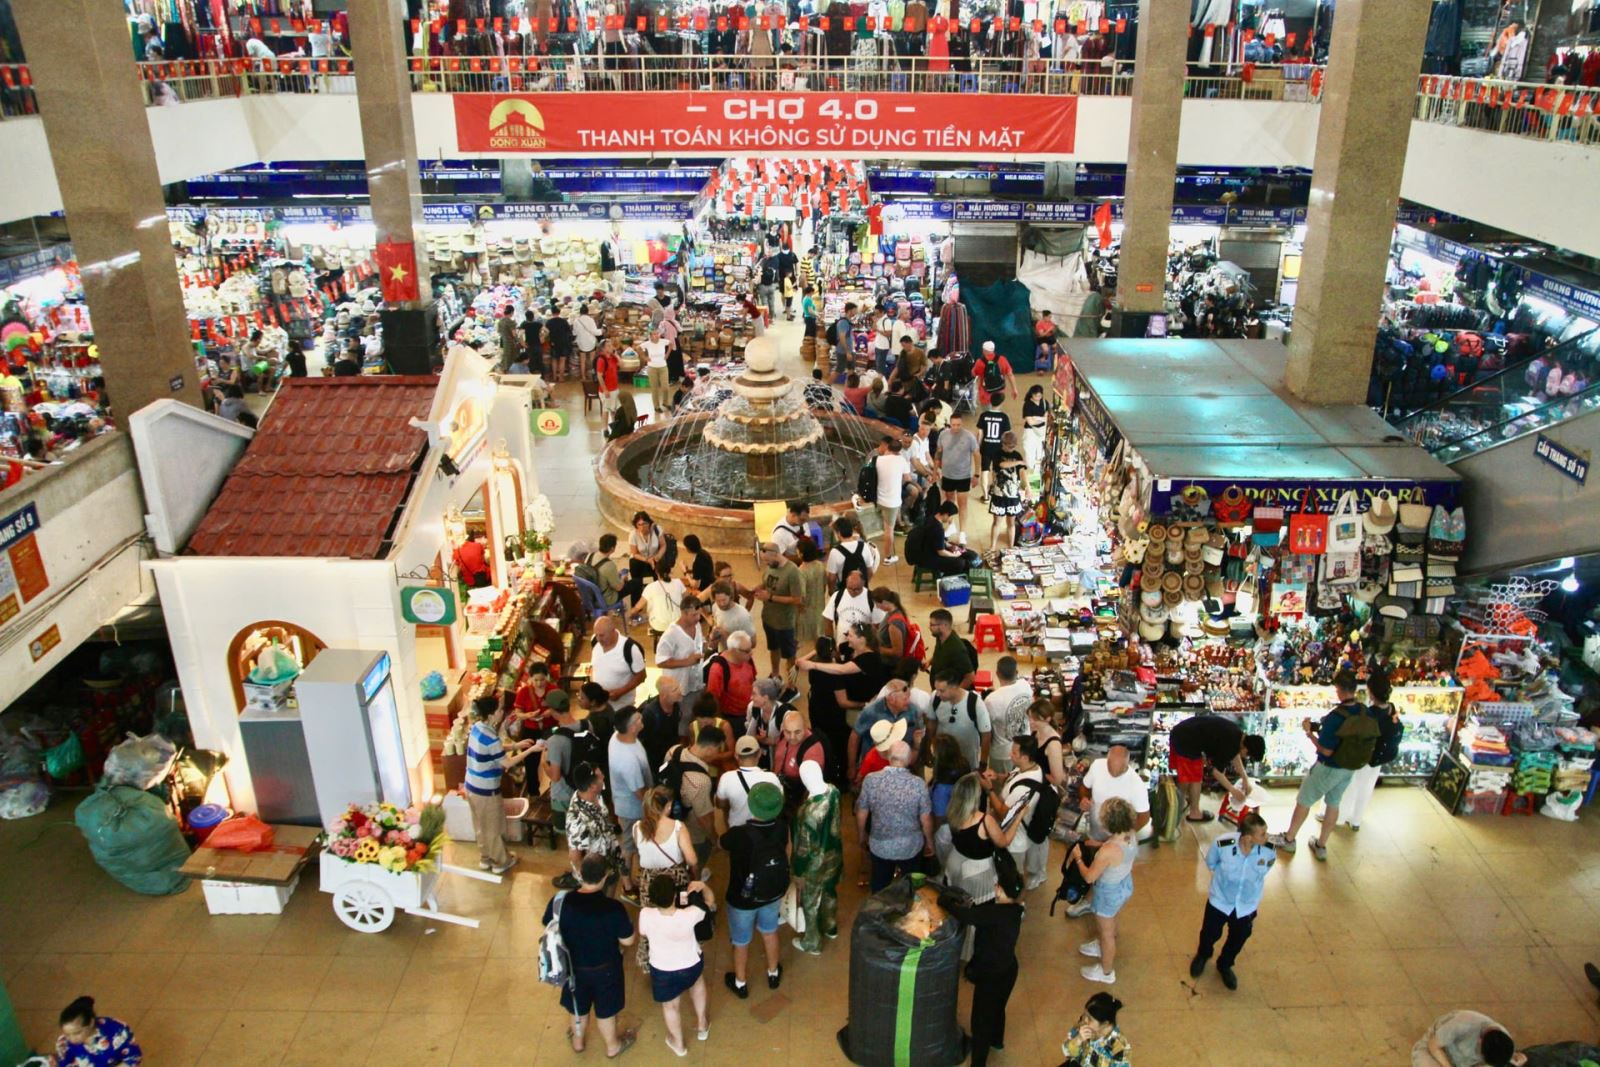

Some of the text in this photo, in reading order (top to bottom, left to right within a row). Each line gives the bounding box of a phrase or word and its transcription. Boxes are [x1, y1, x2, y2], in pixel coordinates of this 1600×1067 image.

[724, 97, 805, 124] CHỢ
[819, 99, 878, 120] 4.0
[577, 123, 1025, 151] THANH TOÁN KHÔNG SỬ DỤNG TIỀN MẶT
[504, 205, 545, 213] DUNG
[1037, 204, 1074, 212] NAM OANH
[1543, 279, 1571, 297] QUANG
[986, 421, 1000, 438] 10
[1537, 440, 1585, 479] CẦU THANG SỐ 10
[0, 511, 34, 546] ANG SỐ 9
